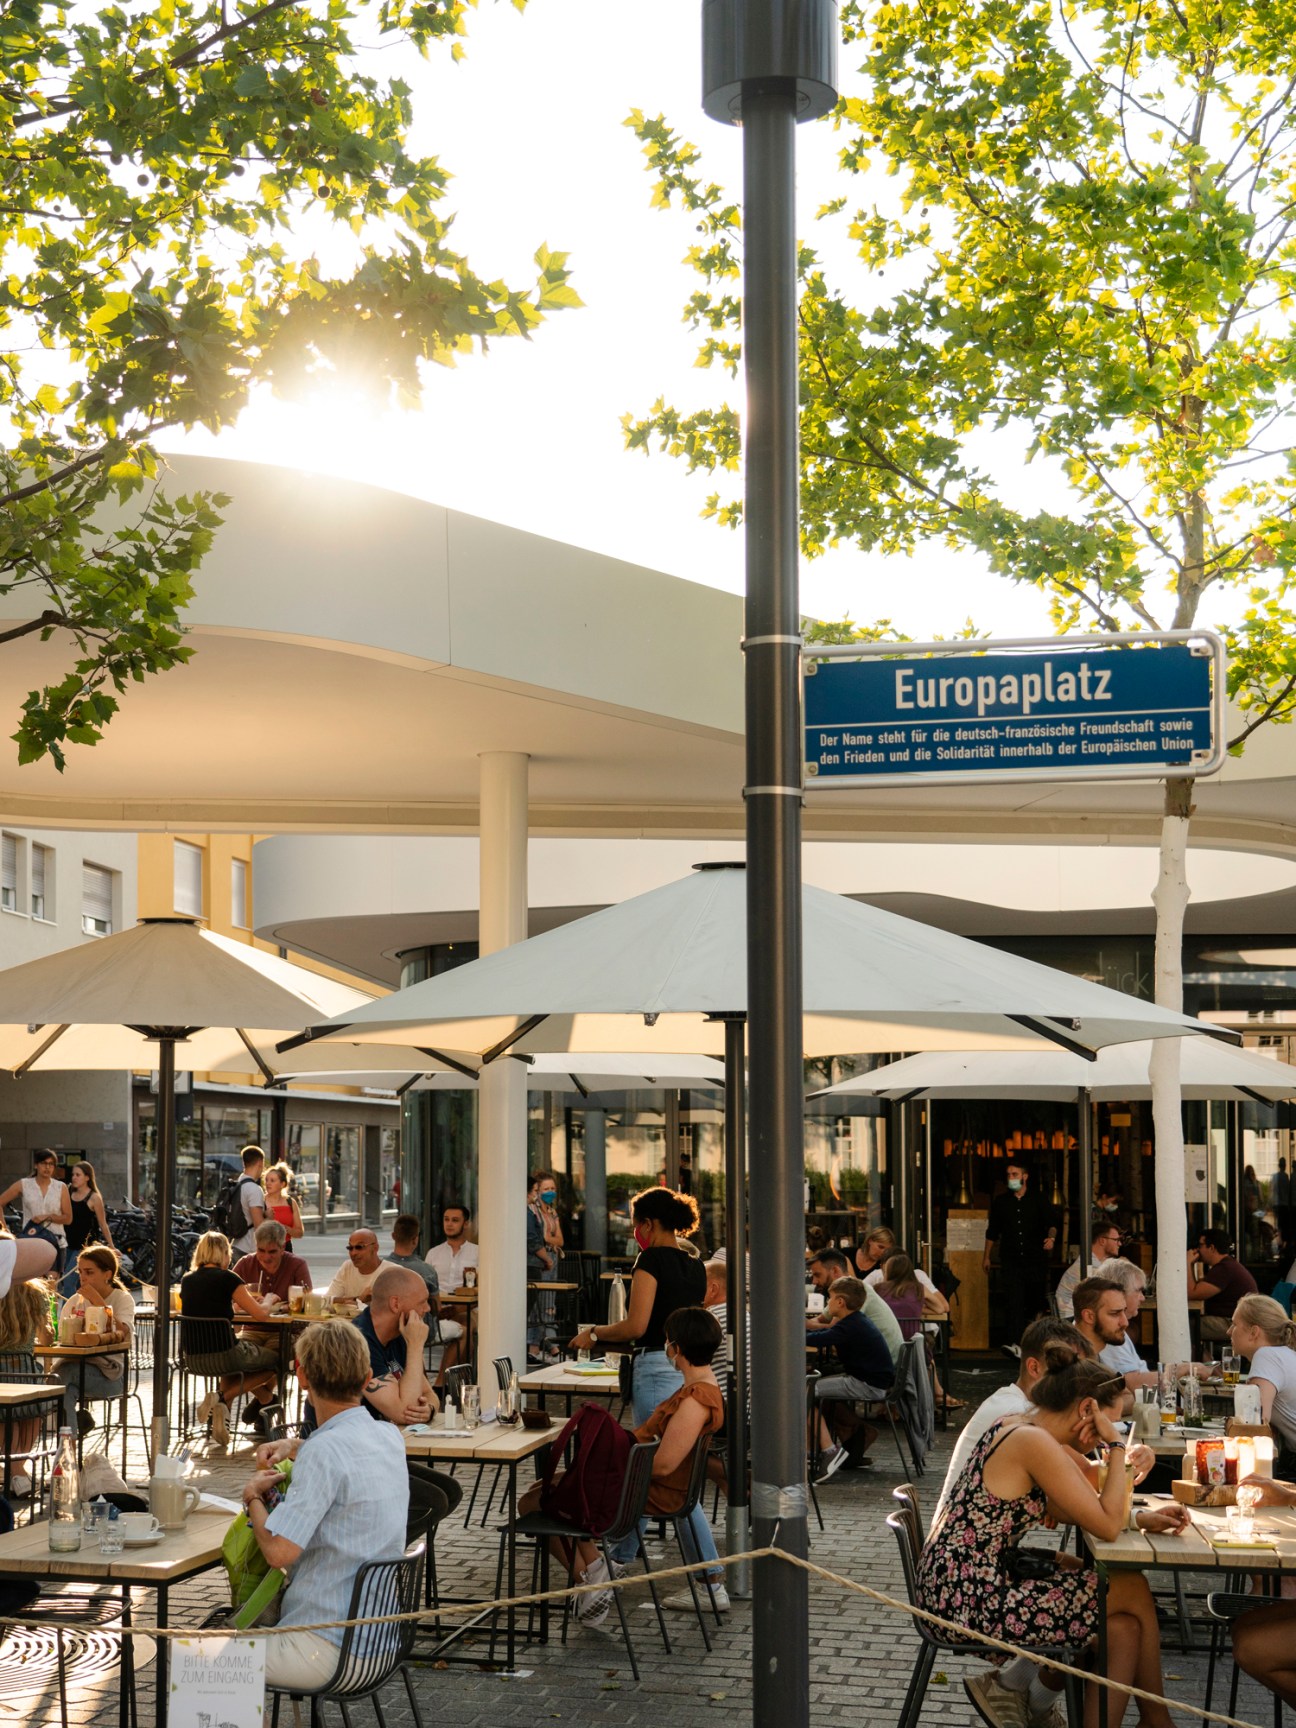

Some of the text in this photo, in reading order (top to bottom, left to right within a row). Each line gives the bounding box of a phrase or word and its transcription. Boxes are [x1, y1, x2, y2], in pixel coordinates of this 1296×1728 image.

[895, 661, 1112, 716] Europaplatz
[820, 717, 1194, 747] Der Name steht für die deutsch-französische Freundschaft sowie
[820, 736, 1195, 765] den Frieden und die Solidarität innerhalb der Europäischen Union
[1081, 951, 1150, 996] lück
[180, 1670, 254, 1684] ZUM EINGANG
[184, 1656, 253, 1669] BITTE KOMME
